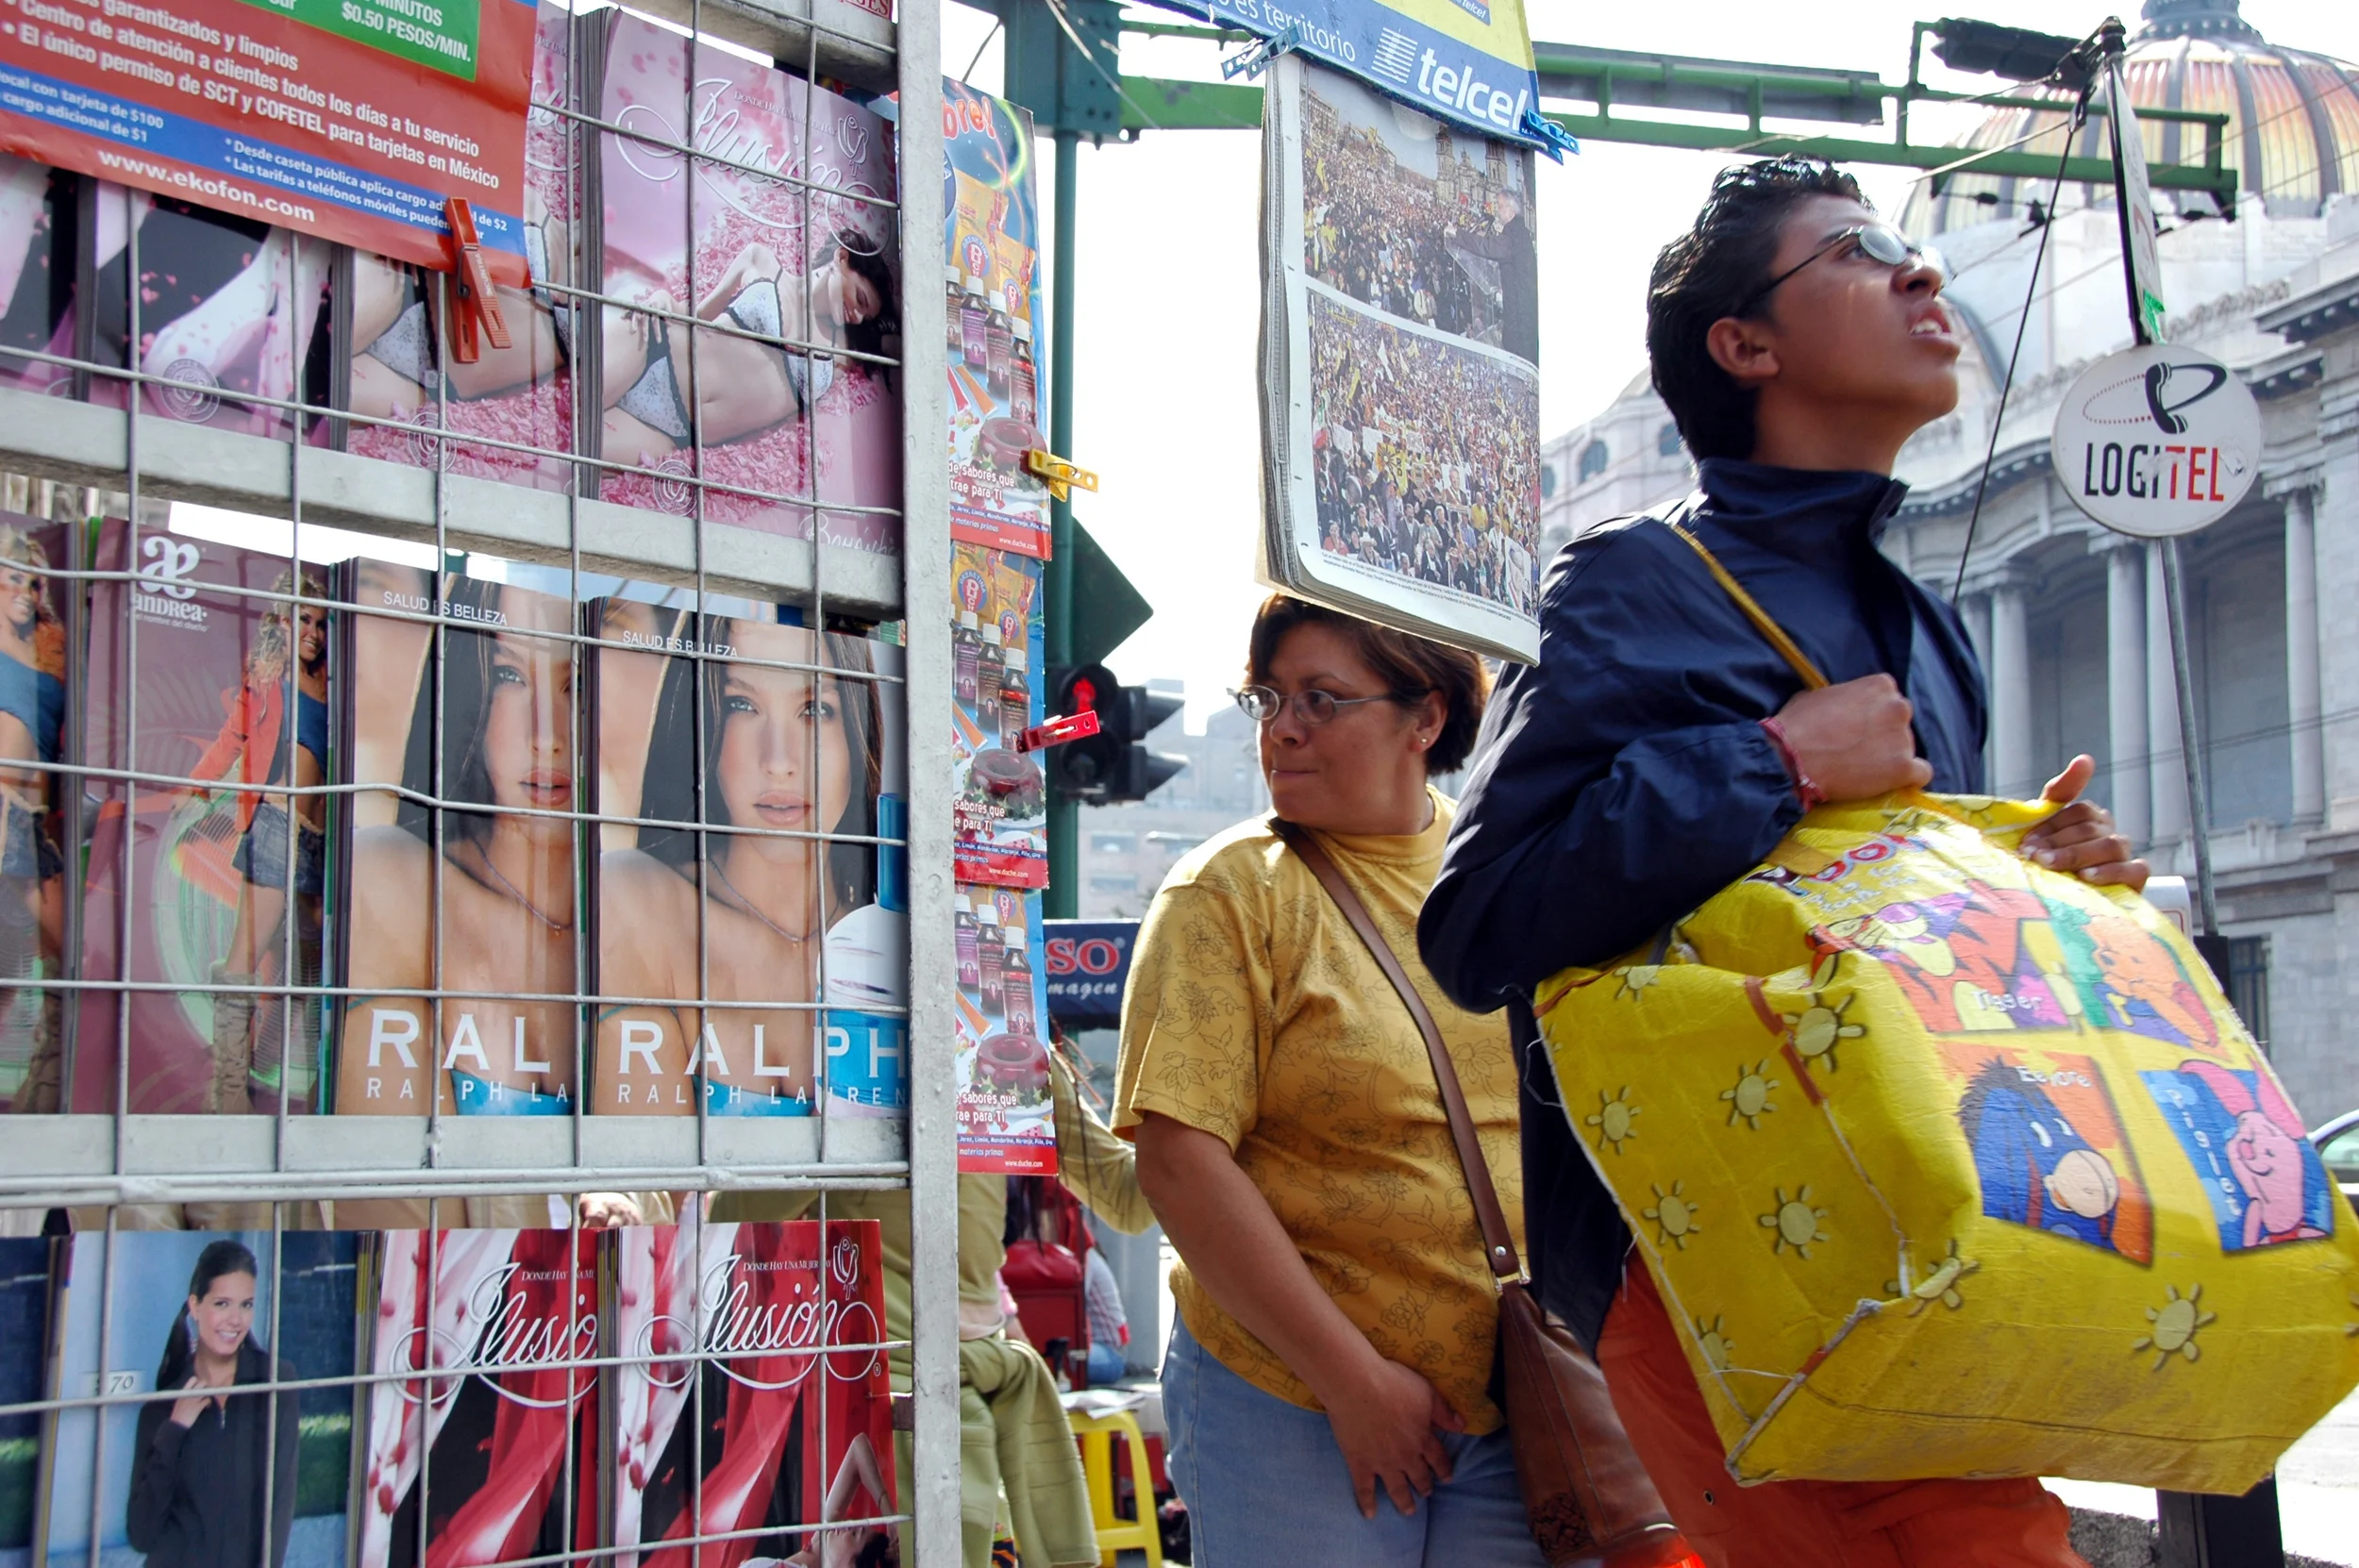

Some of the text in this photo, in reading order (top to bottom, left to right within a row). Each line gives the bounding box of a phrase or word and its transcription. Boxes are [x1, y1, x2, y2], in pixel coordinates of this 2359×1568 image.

[104, 0, 298, 71] garantizados y limpios
[342, 4, 472, 62] $0.50 PESOS/MIN.
[1263, 2, 1356, 62] territorio
[21, 0, 479, 158] Centro de atención a clientes todos los días a tu servicio
[1420, 48, 1529, 132] telcel
[18, 23, 499, 190] El único permiso de SCT y COFETEL para tarjetas en México
[31, 81, 58, 98] con
[61, 89, 108, 113] tarjeta
[110, 102, 128, 120] de
[130, 107, 164, 129] $100
[734, 92, 765, 108] DONDE
[46, 104, 109, 131] adicional
[111, 121, 129, 138] de
[132, 125, 147, 142] $1
[98, 149, 316, 224] www.ekofon.com
[233, 158, 255, 175] Las
[257, 166, 295, 187] tarifas
[297, 178, 305, 190] a
[307, 179, 361, 206] teléfonos
[364, 196, 408, 220] móviles
[410, 210, 451, 232] pueden
[234, 141, 508, 232] Desde caseta pública aplica cargo de $2
[950, 478, 969, 492] trae
[972, 485, 991, 497] para
[962, 465, 996, 482] sabores
[999, 475, 1014, 487] que
[2084, 442, 2224, 502] LOGITEL
[383, 591, 429, 611] SALUD
[454, 604, 508, 626] BELLEZA
[623, 630, 738, 658] SALUD ES BLLEZA
[954, 800, 1005, 818] sabores que
[962, 820, 981, 830] para
[1047, 982, 1117, 1000] magen
[1971, 989, 2044, 1012] Tigger
[367, 1008, 550, 1074] RAL
[618, 1020, 907, 1077] RALPH
[367, 1078, 502, 1101] RAPH
[2016, 1065, 2092, 1089] Eeyore
[618, 1084, 742, 1105] RALPH
[962, 1093, 997, 1105] sabores
[1000, 1096, 1016, 1108] que
[956, 1110, 970, 1121] rae
[973, 1111, 993, 1124] para
[522, 1271, 551, 1281] DONDE
[552, 1270, 568, 1279] HAY
[744, 1262, 769, 1272] DONDE
[770, 1261, 784, 1270] HAY
